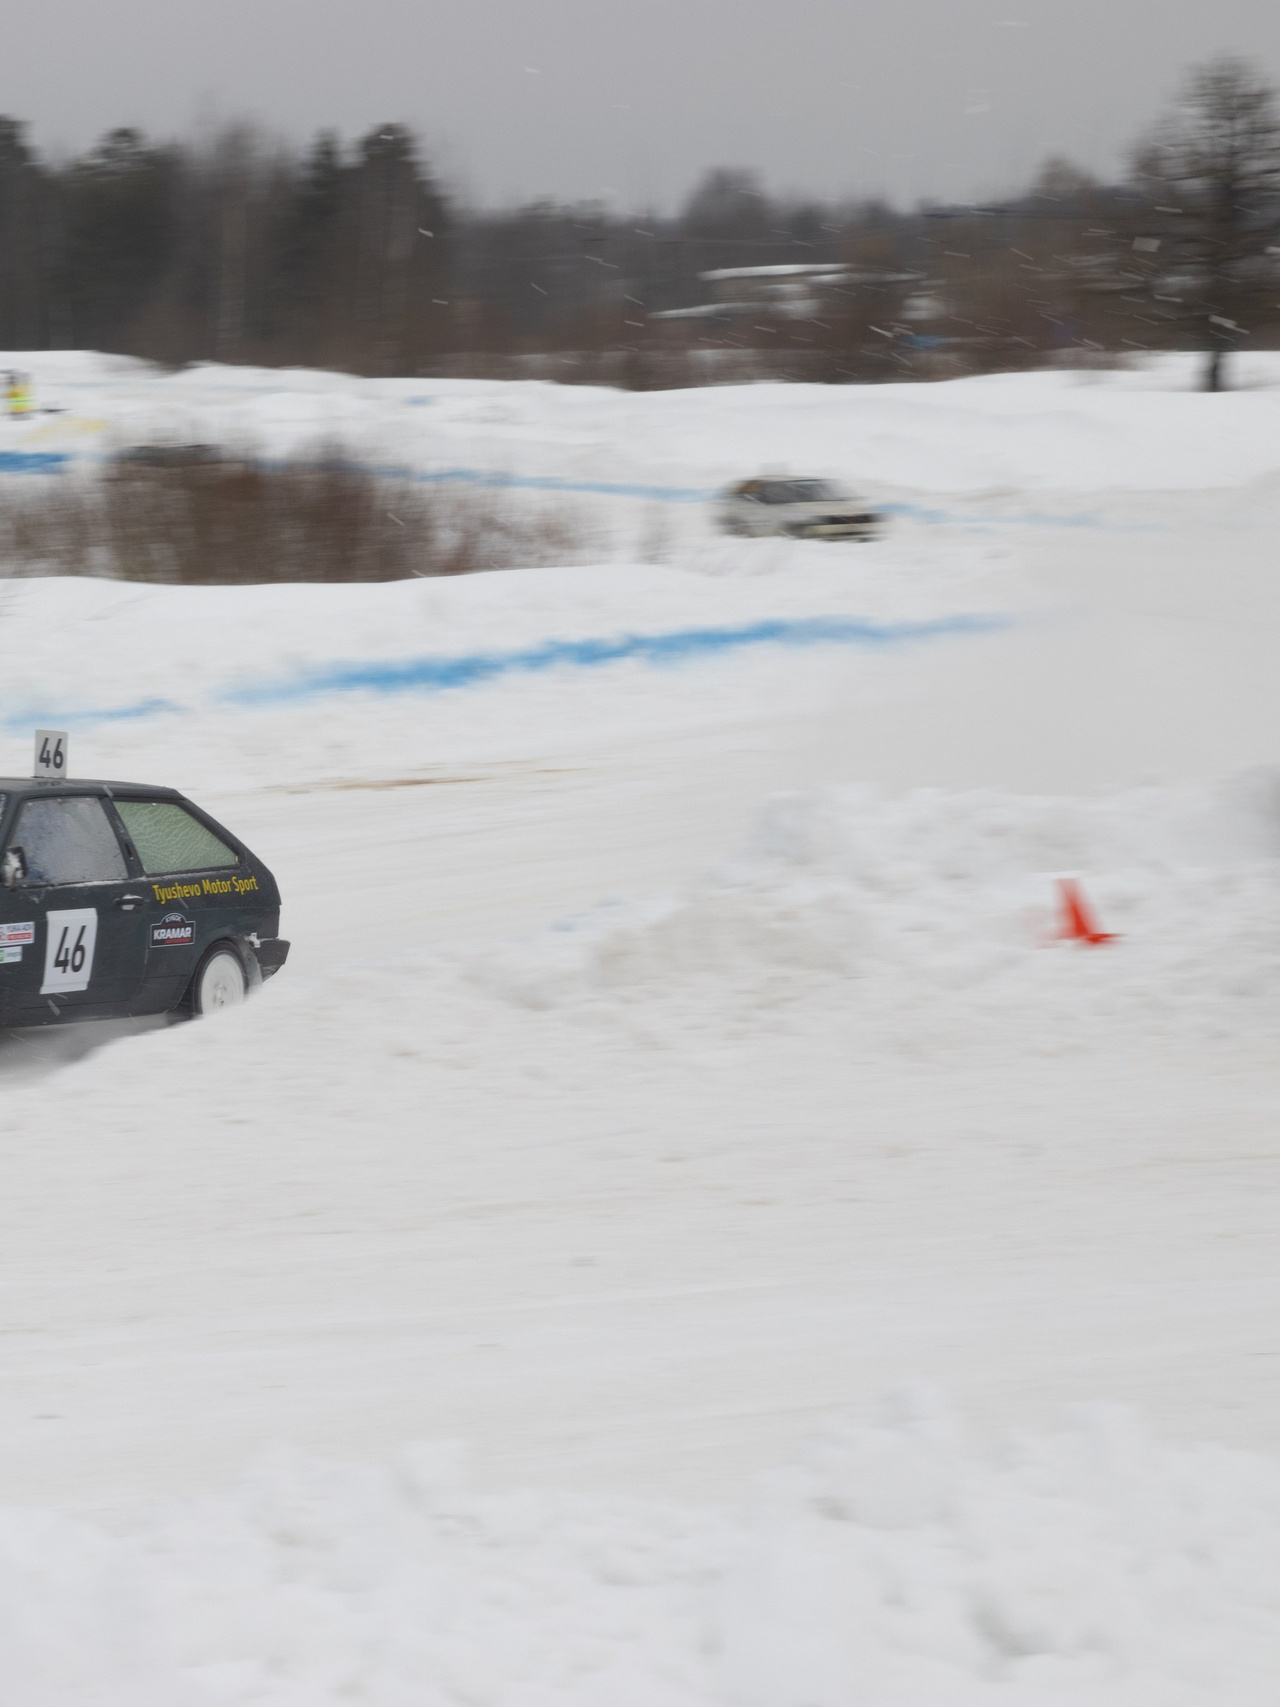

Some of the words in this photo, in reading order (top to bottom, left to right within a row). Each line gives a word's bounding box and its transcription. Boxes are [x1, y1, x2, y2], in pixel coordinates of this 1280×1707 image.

[38, 737, 64, 769] 46
[152, 882, 201, 904] Tyushevo
[201, 879, 232, 895] Motor
[232, 876, 259, 895] Sport
[153, 926, 192, 941] KRAMAR
[53, 925, 87, 974] 46
